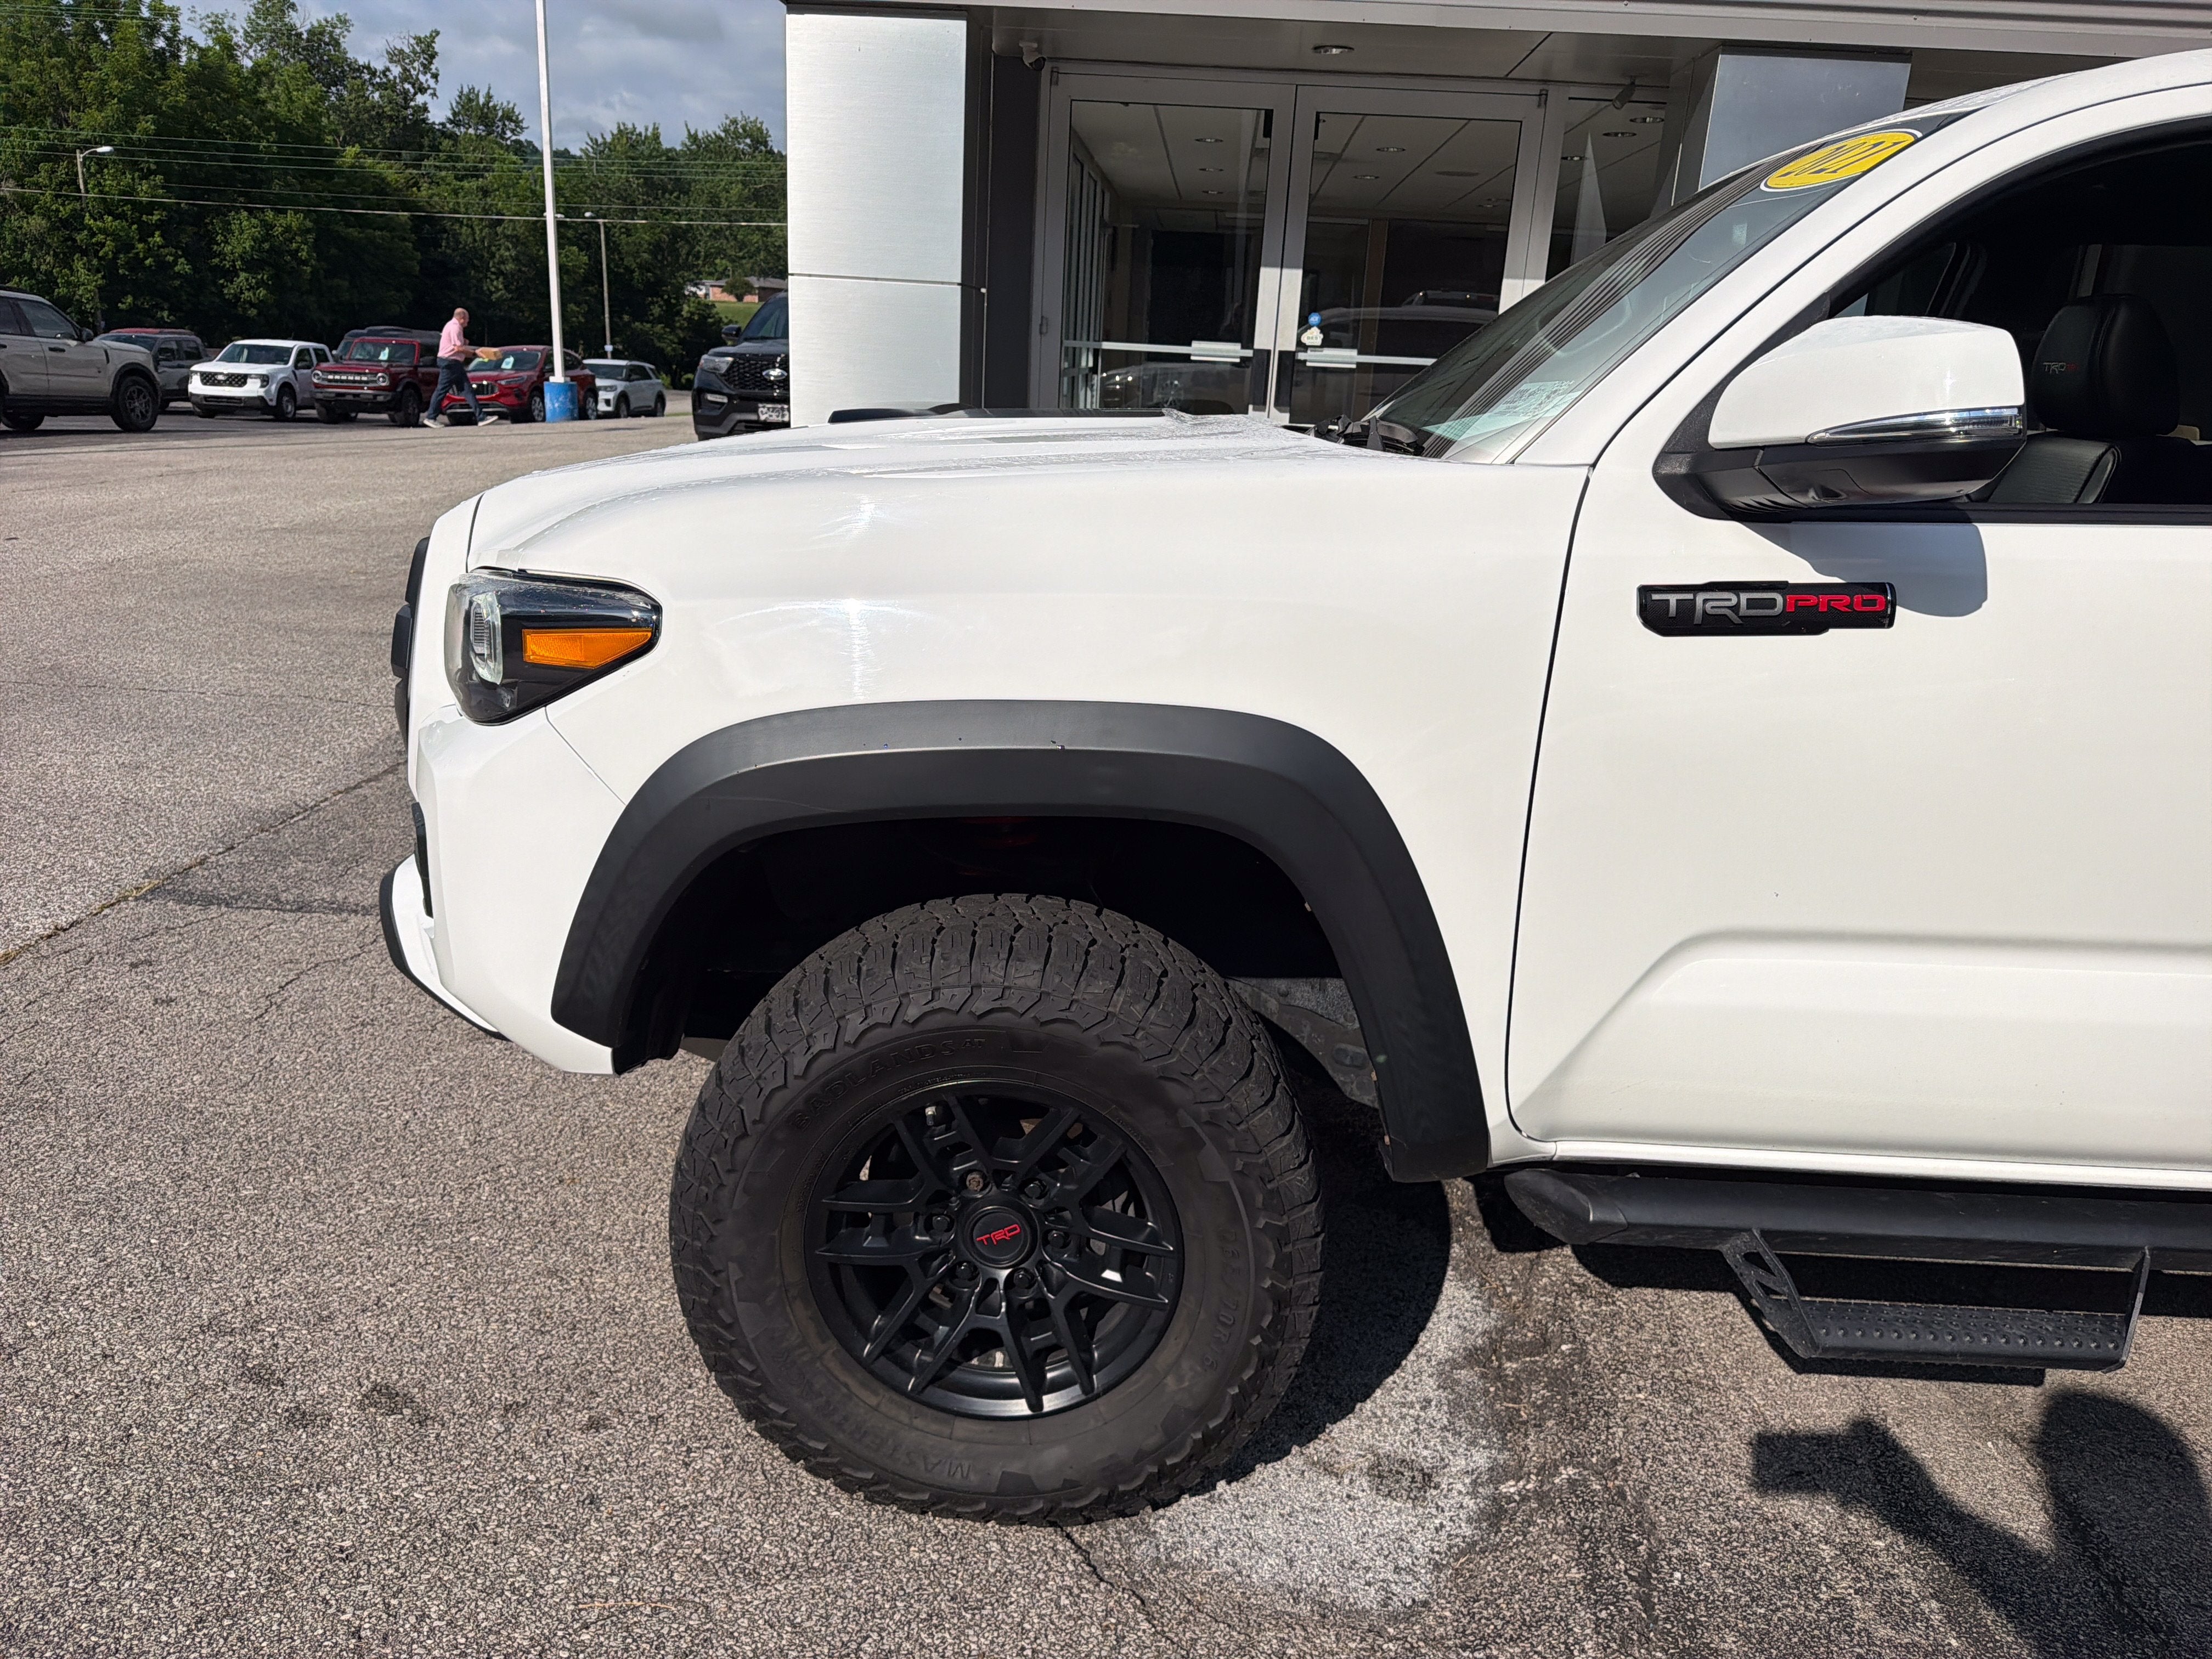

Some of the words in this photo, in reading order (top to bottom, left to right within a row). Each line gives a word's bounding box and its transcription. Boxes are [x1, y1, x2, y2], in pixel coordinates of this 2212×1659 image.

[1775, 139, 1909, 178] 2021
[2043, 362, 2067, 374] TRD
[1651, 592, 1784, 624] TRD
[1785, 594, 1886, 612] PRO
[790, 1040, 955, 1132] BADLANDS
[961, 1039, 986, 1049] AT
[976, 1224, 1021, 1245] TRD
